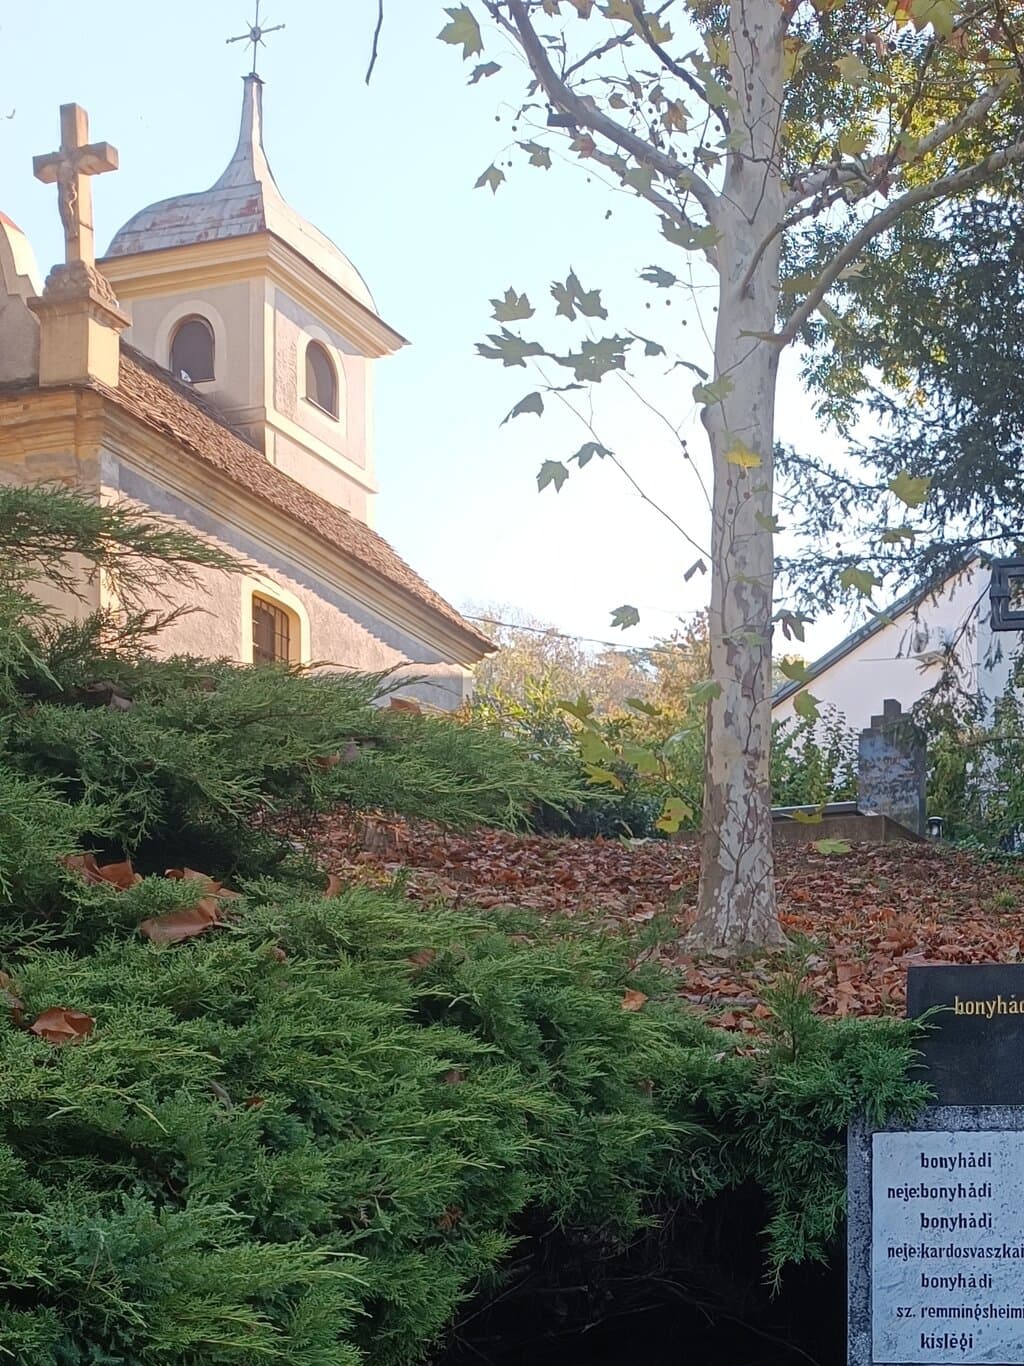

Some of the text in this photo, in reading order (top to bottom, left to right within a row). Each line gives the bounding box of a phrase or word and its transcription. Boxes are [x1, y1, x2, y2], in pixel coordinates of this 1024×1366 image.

[920, 1152, 992, 1172] bonyhádi
[920, 1213, 992, 1232] bonyhádi
[920, 1273, 993, 1292] bonyhádi
[896, 1306, 916, 1318] sz.
[920, 1333, 973, 1352] kislégi
